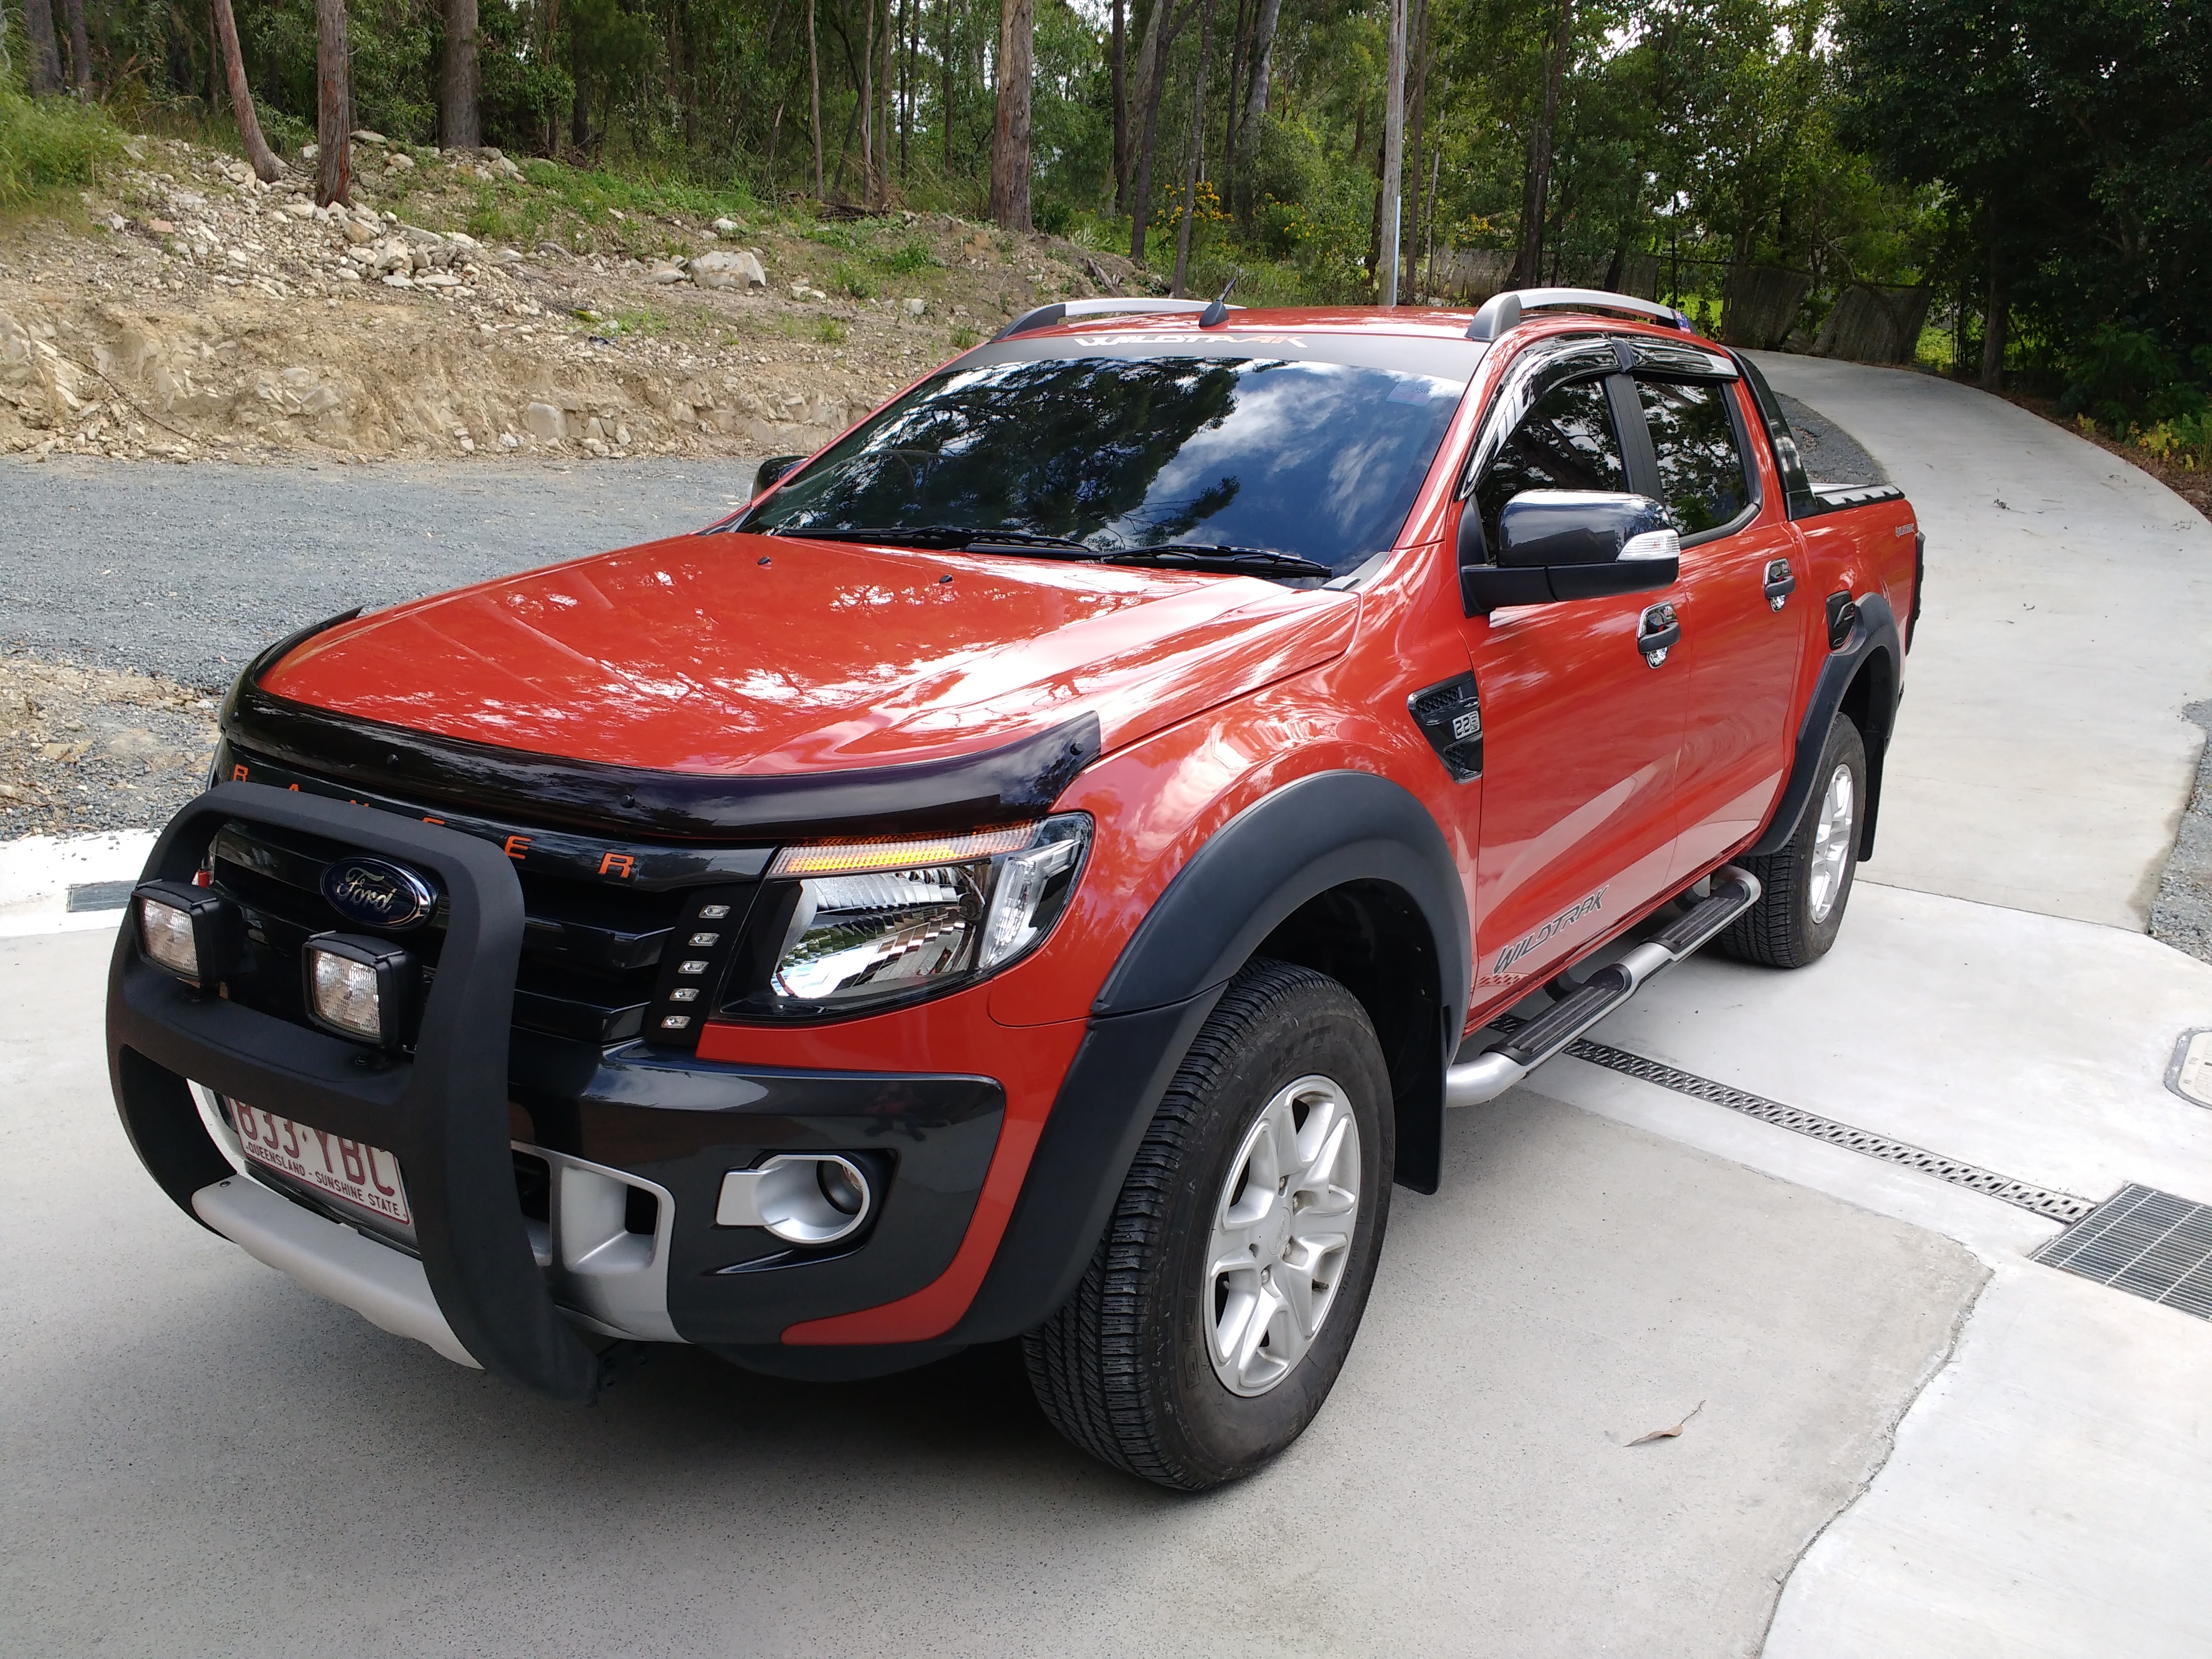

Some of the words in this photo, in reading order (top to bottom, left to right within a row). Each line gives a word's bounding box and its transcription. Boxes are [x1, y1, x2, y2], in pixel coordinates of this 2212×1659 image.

[1074, 335, 1308, 348] WILDTRAK
[337, 867, 397, 914] Ford
[1493, 884, 1610, 976] WILDTRAK
[248, 1142, 305, 1176] QUEENSLAND
[315, 1171, 364, 1202] SUNSHINE
[368, 1193, 400, 1216] STATE
